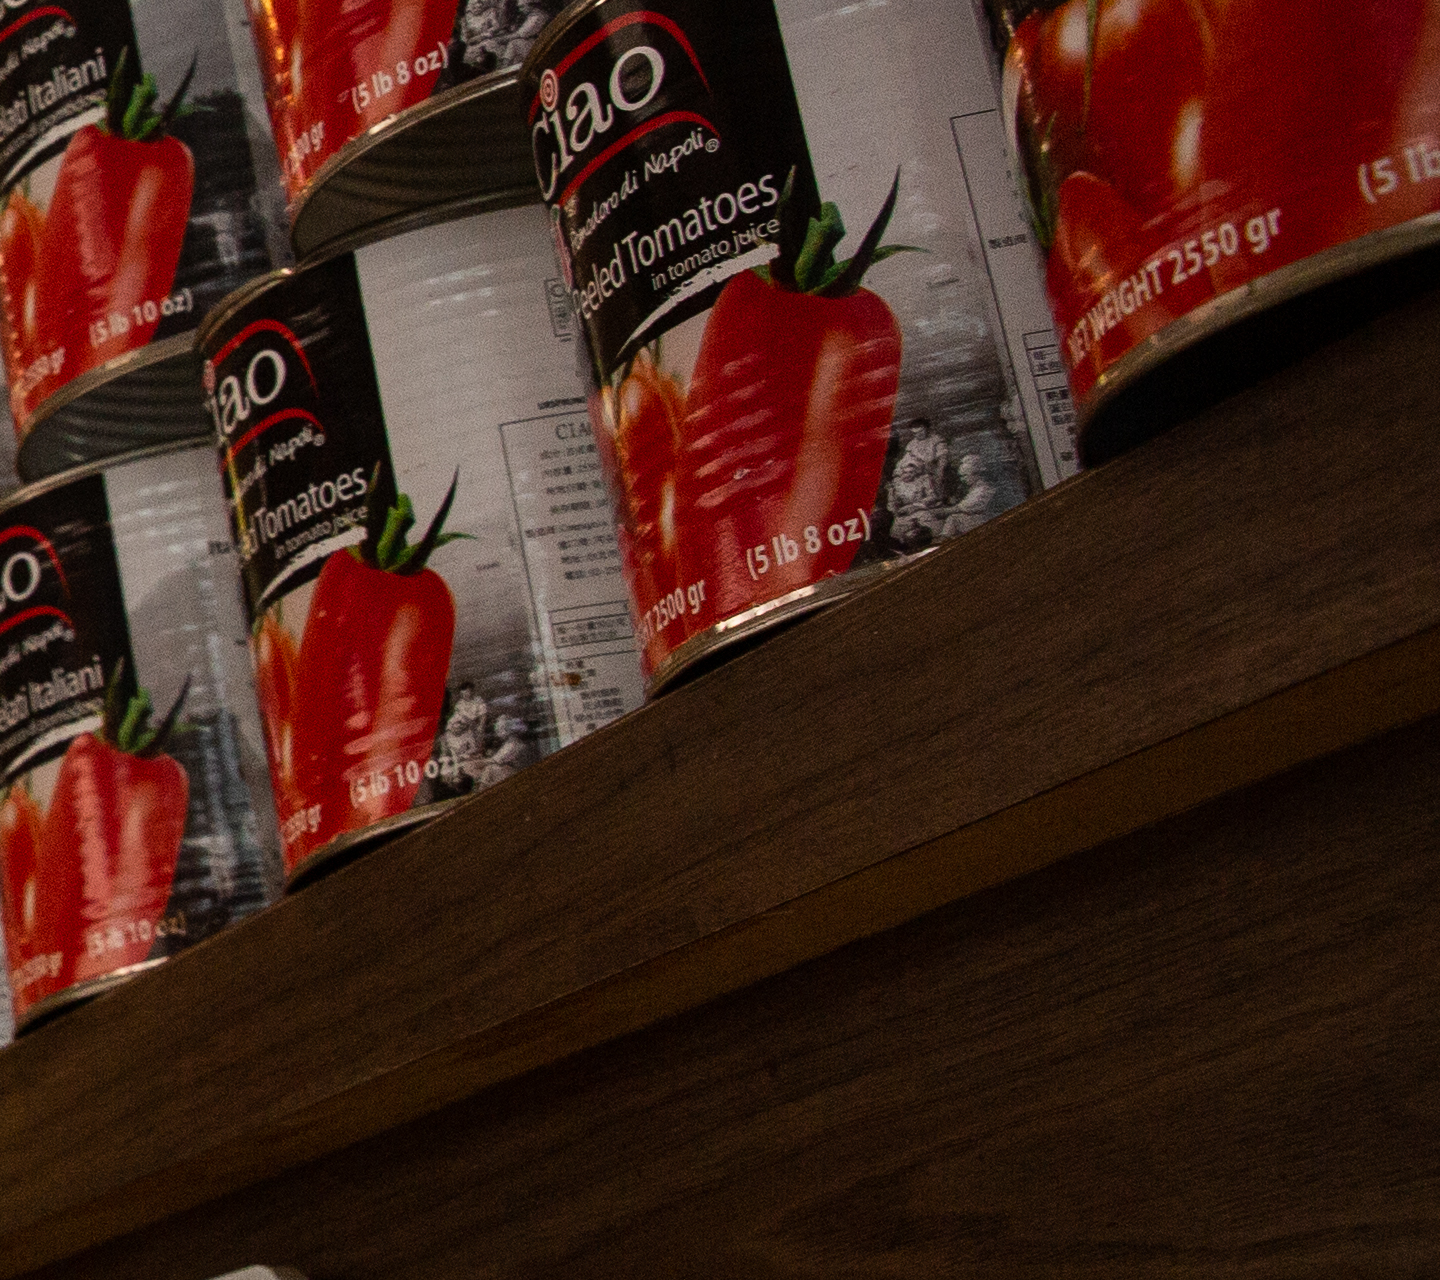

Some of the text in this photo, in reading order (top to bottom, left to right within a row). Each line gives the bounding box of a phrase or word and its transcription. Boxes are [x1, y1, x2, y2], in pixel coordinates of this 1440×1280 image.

[28, 46, 108, 115] Italiani
[350, 41, 449, 115] (5 lb 8 oz)
[532, 45, 665, 201] Ciao
[1358, 156, 1399, 205] (5
[621, 174, 780, 274] Tomatoes
[666, 238, 731, 282] tomato
[1088, 260, 1165, 345] WEIGHT
[1169, 218, 1241, 285] 2550
[1245, 206, 1282, 256] gr
[132, 300, 159, 326] 10
[254, 467, 368, 544] Tomatoes
[745, 507, 871, 582] (5 lb 8 oz)
[652, 578, 707, 633] 2500 gr
[393, 759, 422, 790] 10
